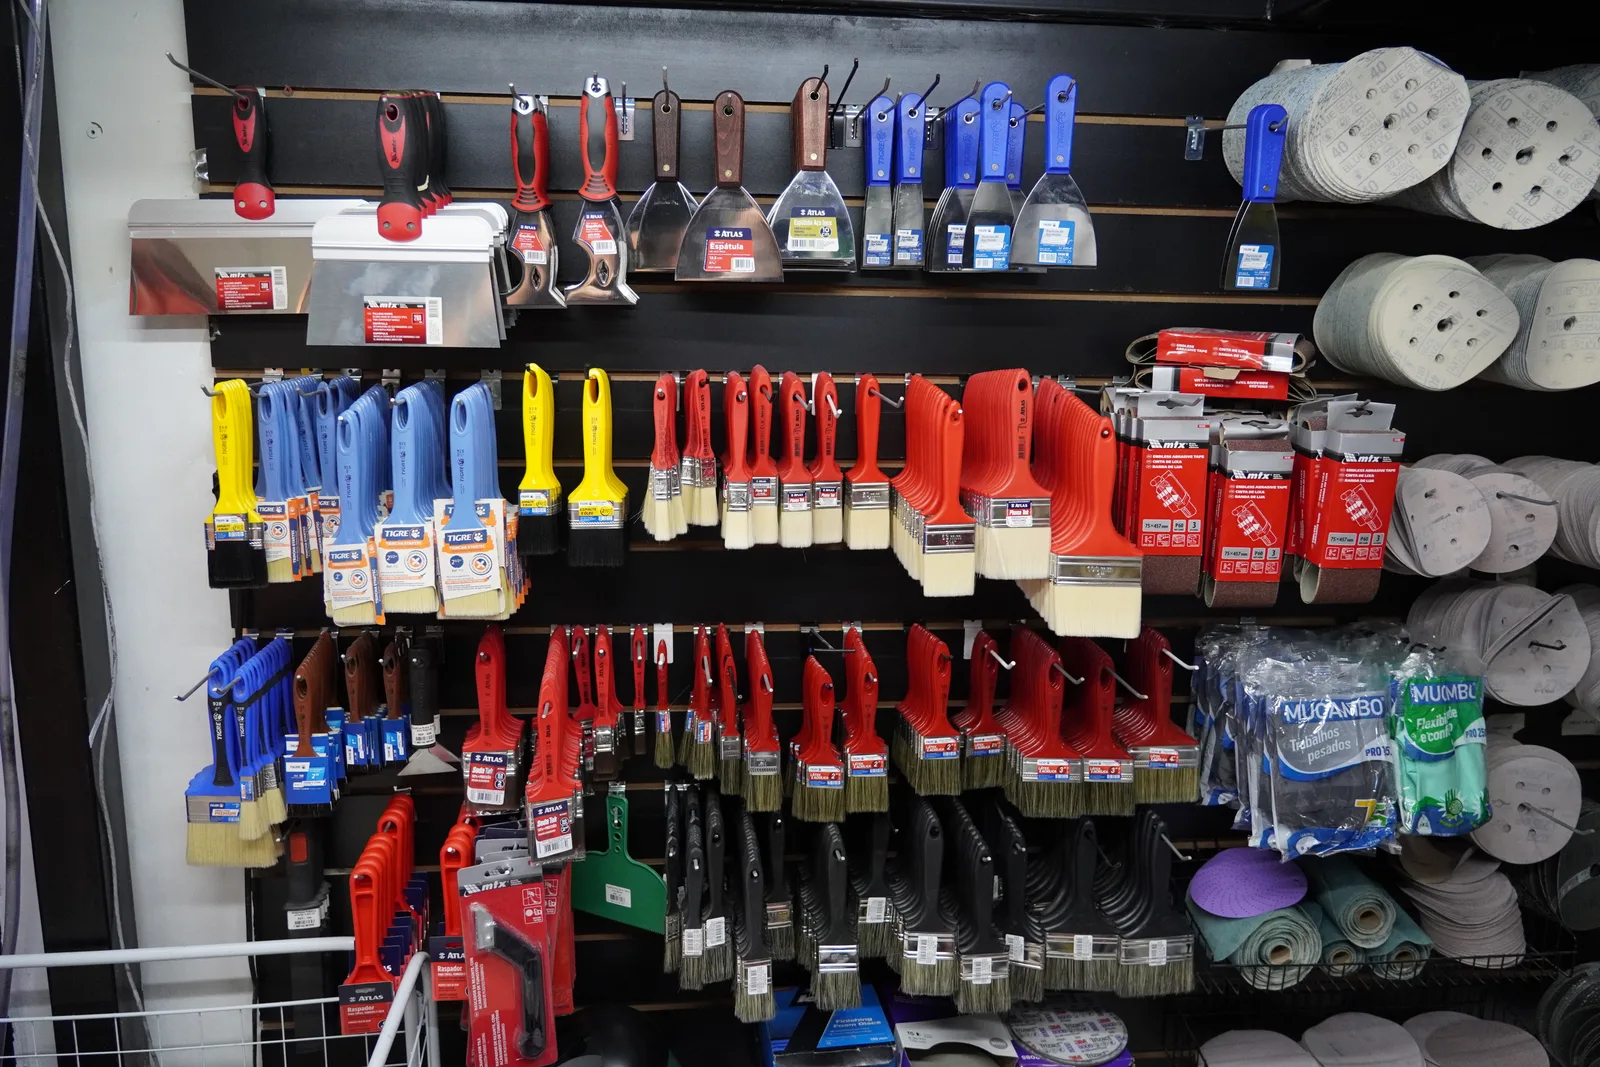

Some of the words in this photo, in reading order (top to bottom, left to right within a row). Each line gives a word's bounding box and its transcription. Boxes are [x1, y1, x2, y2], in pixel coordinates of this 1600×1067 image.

[1380, 71, 1405, 93] BLUE
[1400, 102, 1417, 118] 40
[1547, 163, 1573, 182] BLUE
[721, 230, 743, 238] ATLAS
[710, 243, 744, 251] Espátula
[1163, 441, 1185, 449] mtx
[1247, 472, 1269, 480] mtx
[1192, 521, 1196, 529] 3
[447, 534, 472, 542] TIGRE
[1284, 699, 1384, 722] MUCAMBO
[1465, 728, 1476, 738] PRO
[1290, 728, 1340, 752] Trabalhos
[1307, 739, 1351, 765] pesados
[1366, 746, 1382, 757] PRO
[483, 755, 503, 763] ATLAS
[545, 805, 563, 813] ATLAS
[482, 880, 507, 892] mtx
[358, 994, 384, 1002] ATLAS
